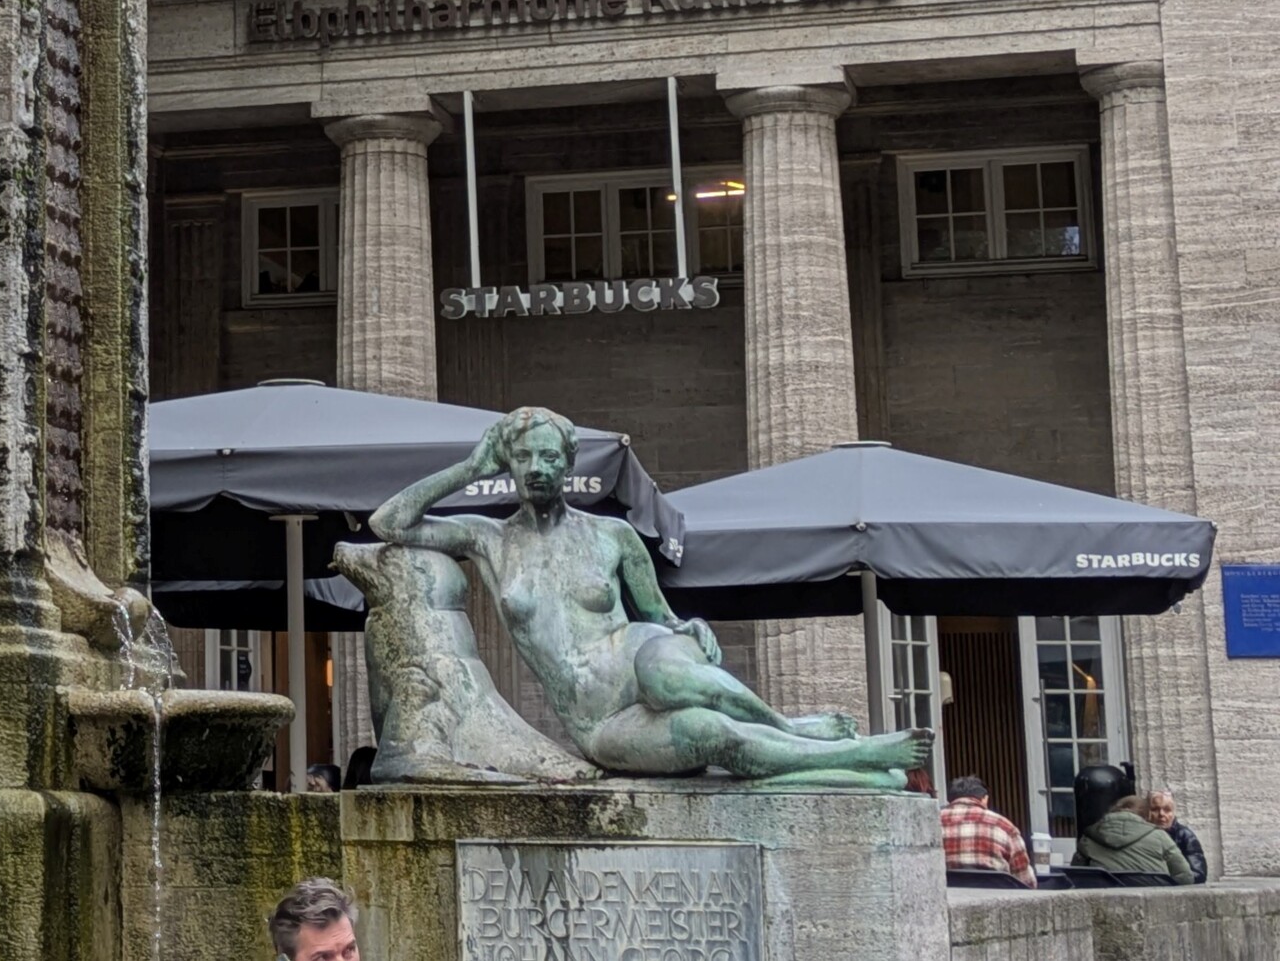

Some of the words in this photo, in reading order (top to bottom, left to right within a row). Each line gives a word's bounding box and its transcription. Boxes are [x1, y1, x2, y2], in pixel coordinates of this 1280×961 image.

[439, 276, 720, 319] STARBUCKS
[464, 476, 602, 496] STACKS
[1076, 552, 1200, 568] STARBUCKS
[468, 868, 534, 902] DEM
[540, 868, 701, 904] ANDENKEN
[702, 869, 750, 904] AN
